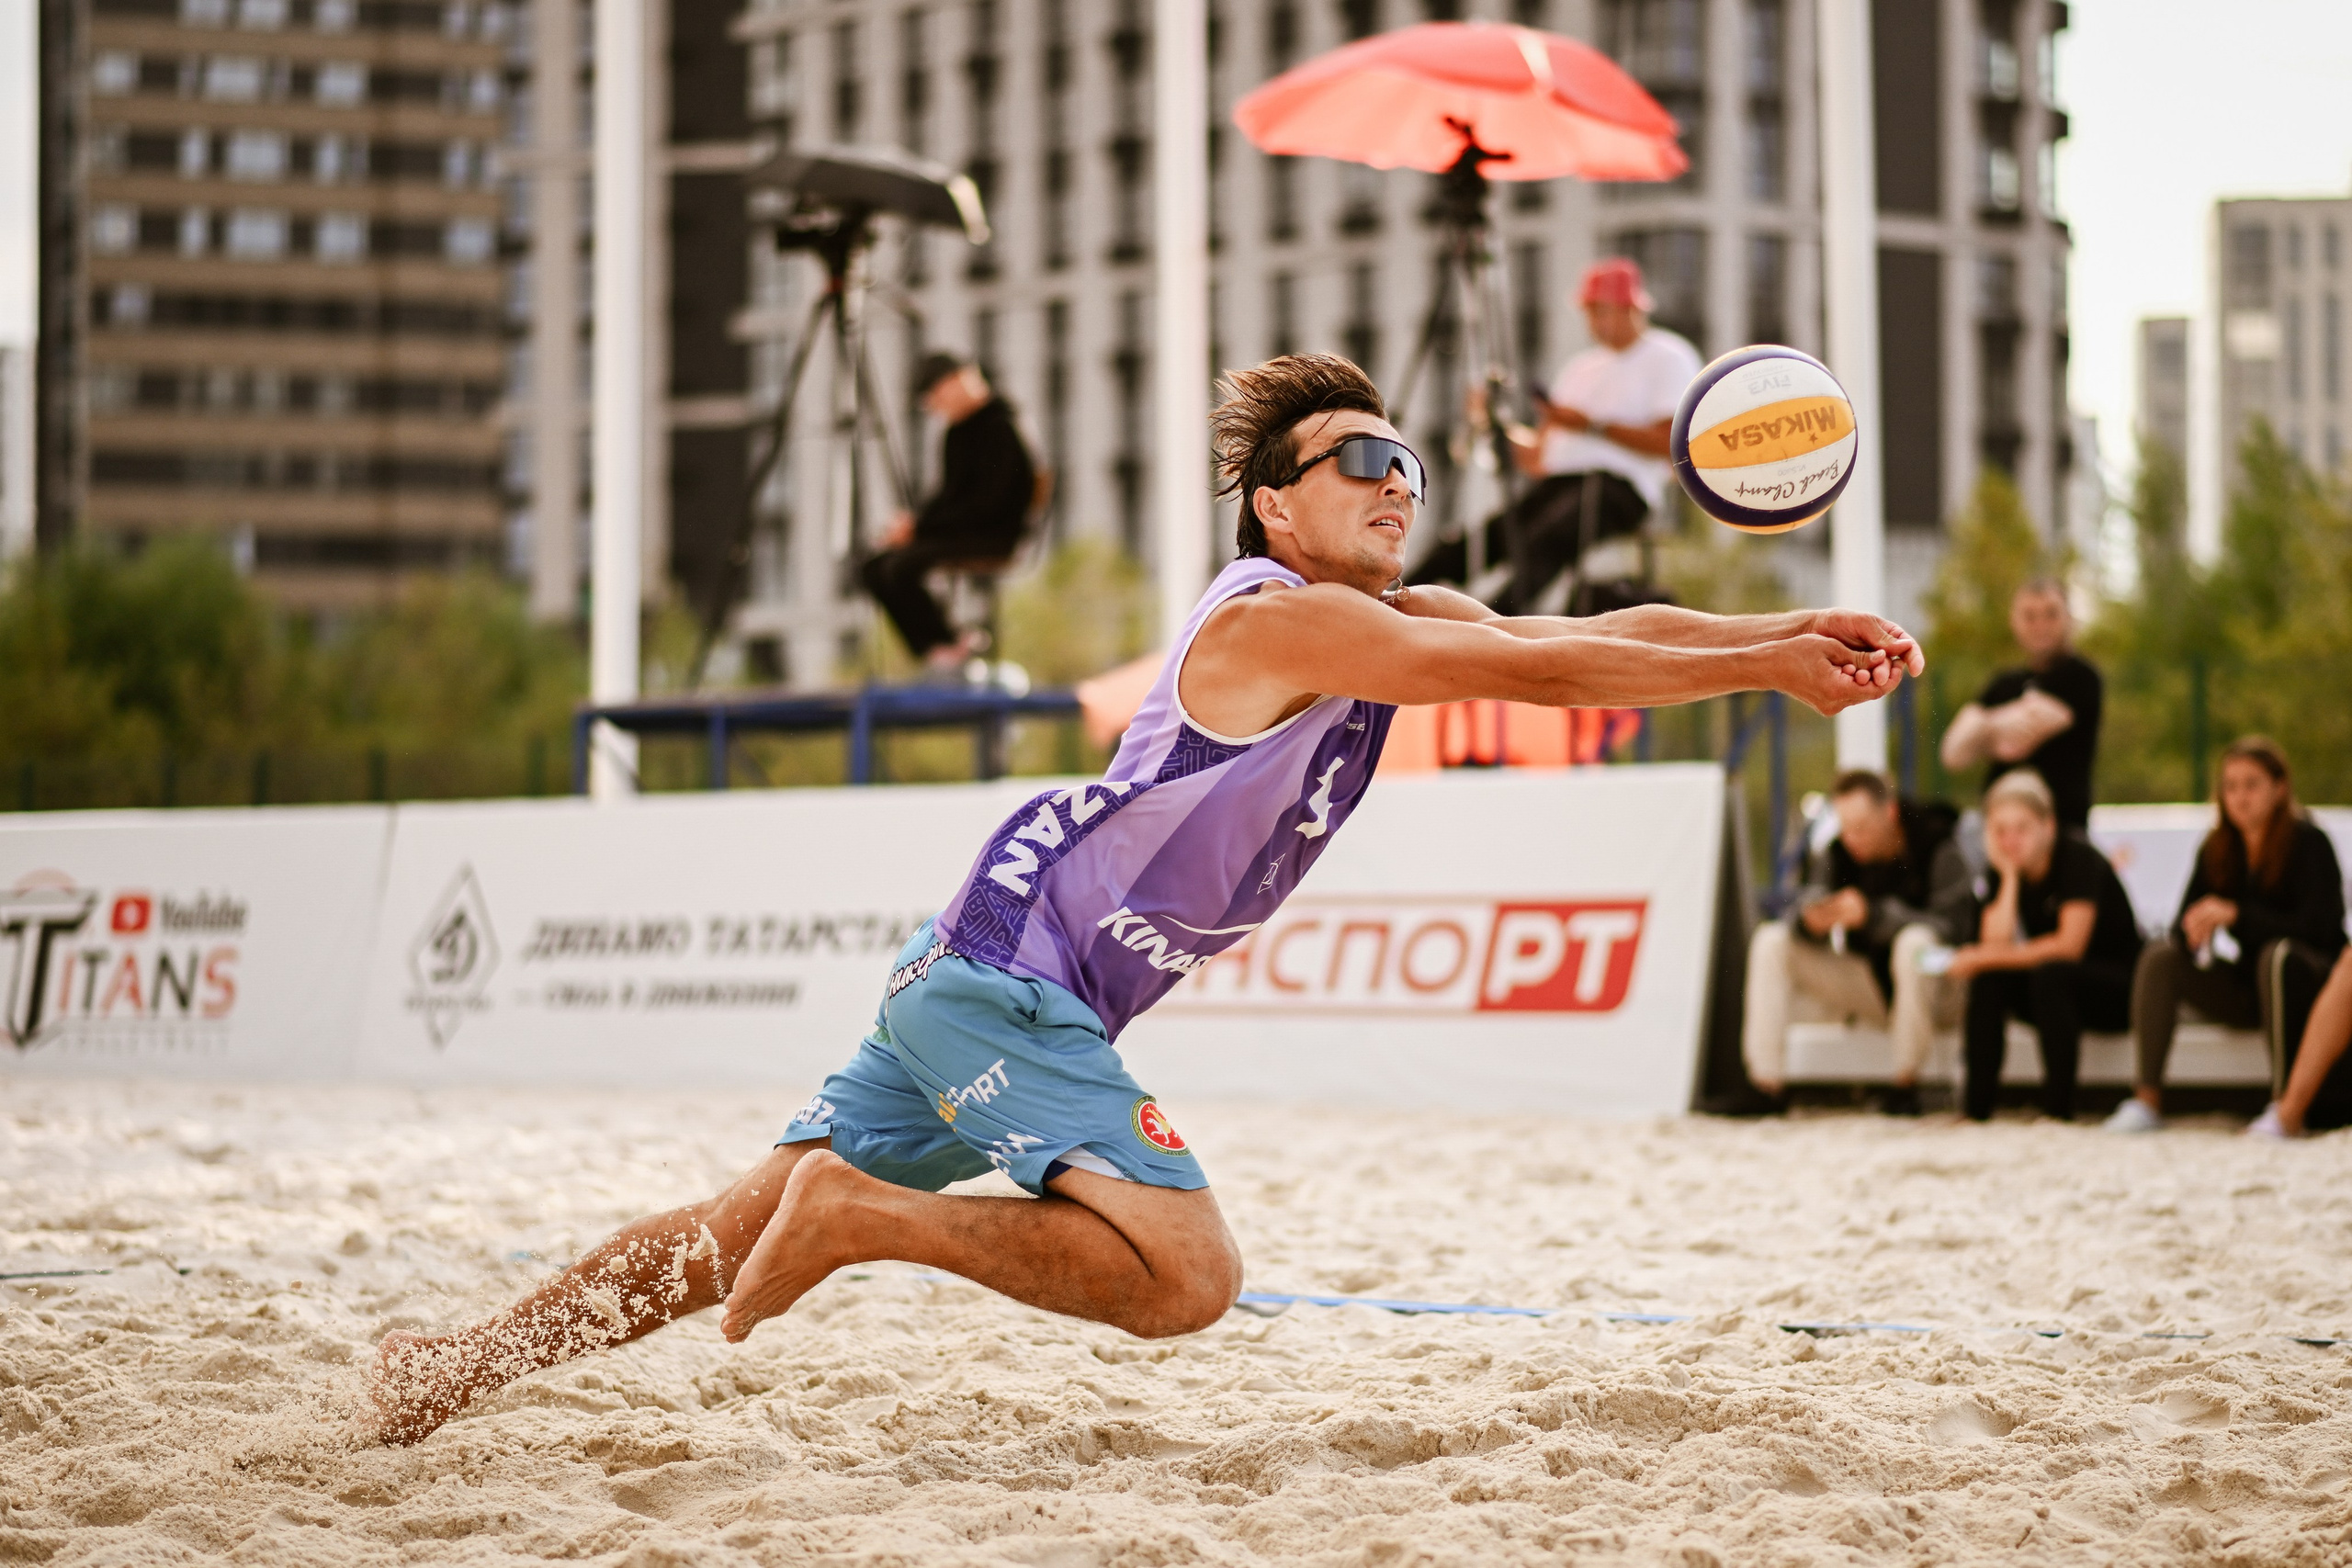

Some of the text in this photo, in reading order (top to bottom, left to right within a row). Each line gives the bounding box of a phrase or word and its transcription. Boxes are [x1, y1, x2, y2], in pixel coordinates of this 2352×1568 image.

[1718, 405, 1838, 452] MIKASA
[1734, 459, 1839, 502] Beach Champ
[705, 916, 924, 961] ТАТАРСТА
